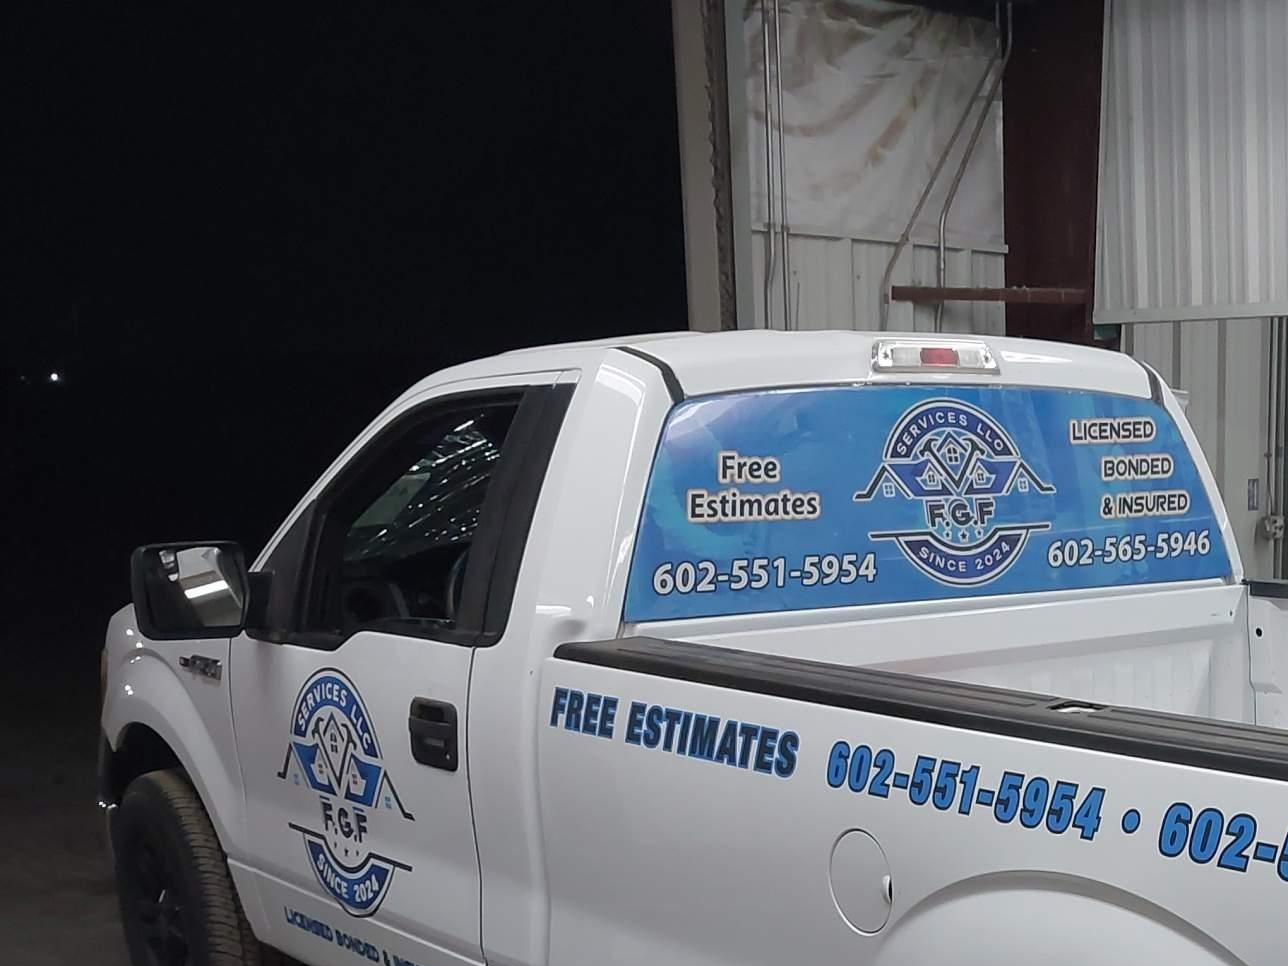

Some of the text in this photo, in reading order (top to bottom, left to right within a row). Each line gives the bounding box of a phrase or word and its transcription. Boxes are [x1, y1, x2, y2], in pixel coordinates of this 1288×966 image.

[896, 411, 968, 456] SERVICES
[1071, 420, 1155, 441] LICENSED
[719, 453, 780, 481] Free
[1102, 456, 1173, 478] BONDED
[688, 490, 819, 519] Estimates
[1102, 493, 1189, 516] & INSURED
[918, 540, 1011, 573] SINCE 2024
[1047, 529, 1211, 568] 602-565-5946
[652, 552, 878, 595] 602-551-5954
[297, 682, 371, 750] SERVICES LLC
[549, 686, 619, 740] FREE
[624, 701, 801, 779] ESTIMATES
[825, 740, 1107, 842] 602-551-5954
[317, 853, 380, 904] SINCE 2024
